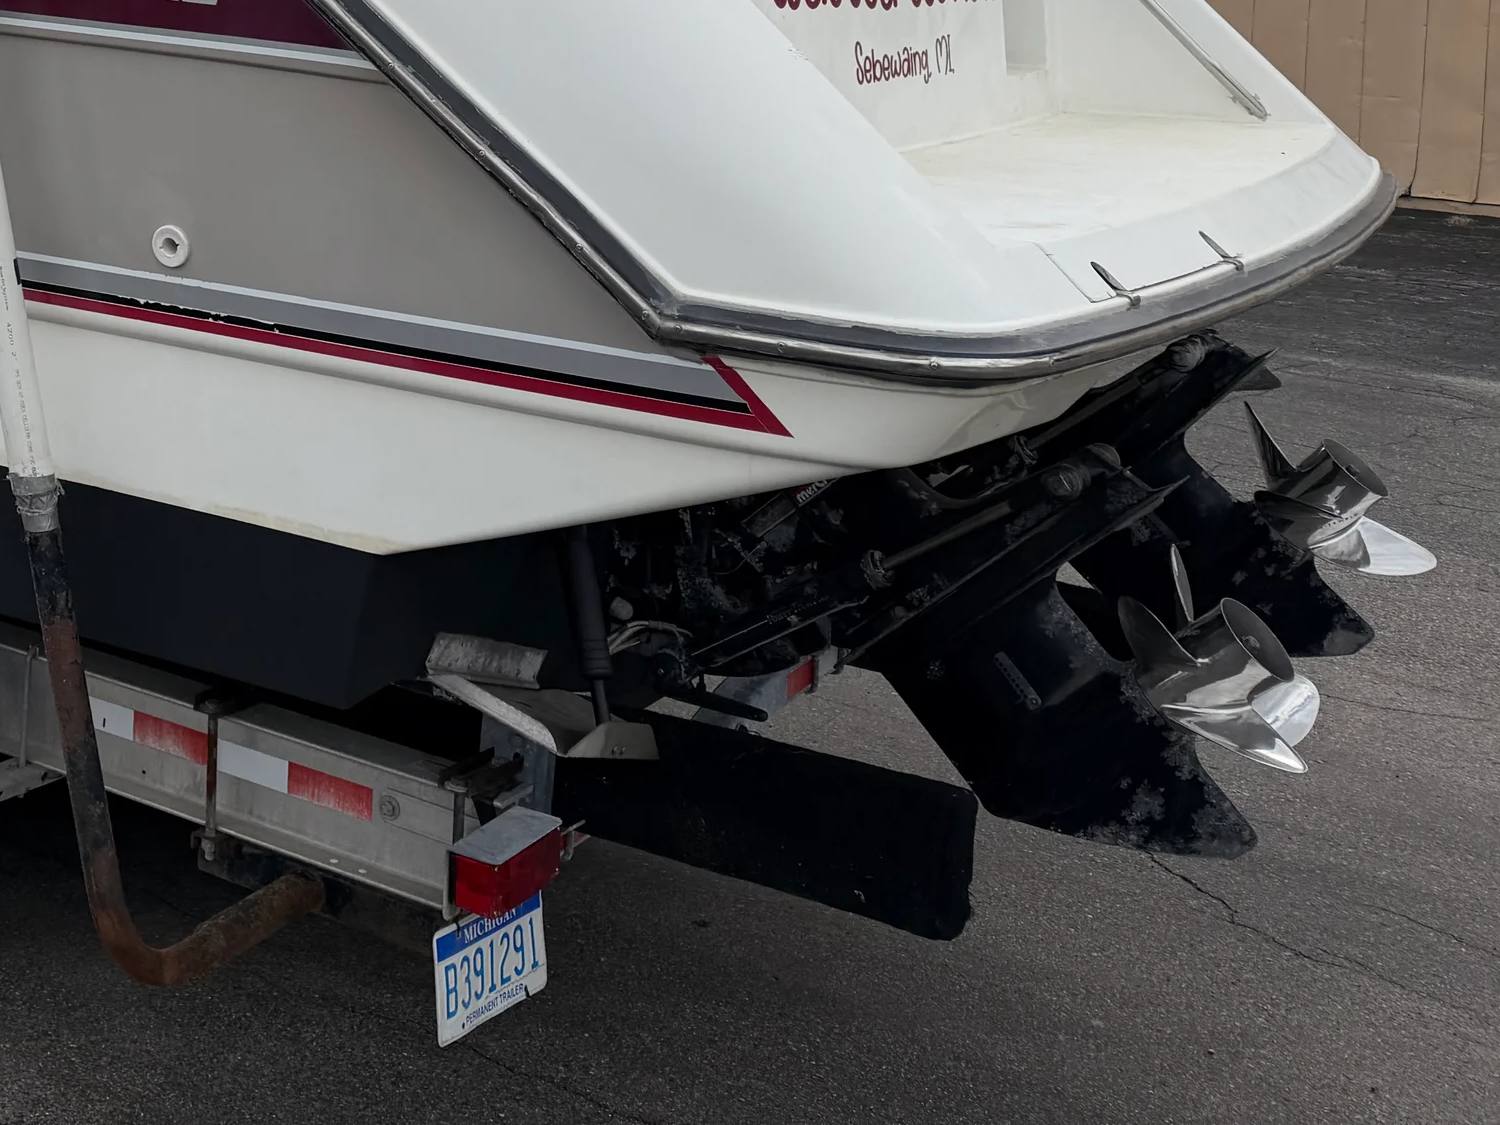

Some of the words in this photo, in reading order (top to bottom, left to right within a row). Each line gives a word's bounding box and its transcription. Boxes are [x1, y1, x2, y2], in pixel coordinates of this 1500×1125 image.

[444, 917, 539, 1020] B391291
[466, 996, 499, 1025] PERMANENT
[499, 983, 524, 1003] TRAILER
